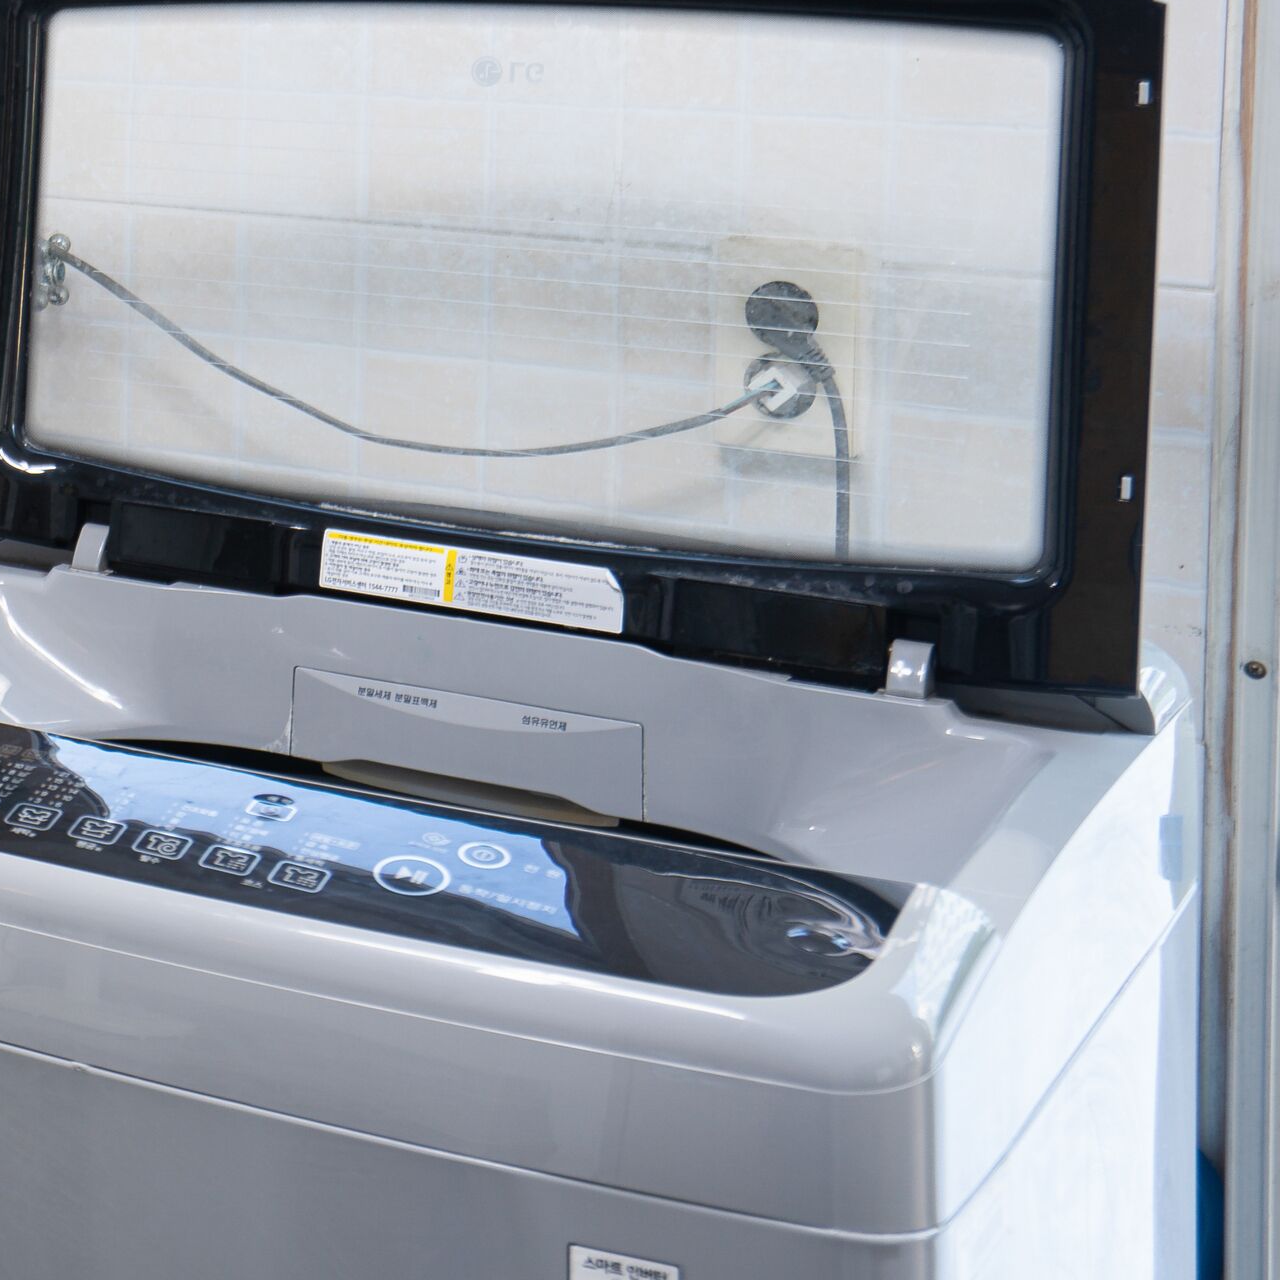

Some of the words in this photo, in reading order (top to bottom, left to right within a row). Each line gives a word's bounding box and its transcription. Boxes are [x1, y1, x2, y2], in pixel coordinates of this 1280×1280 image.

[369, 582, 399, 594] 1544-7777
[357, 685, 392, 701] 분말세제
[395, 692, 439, 710] 분말표백제
[521, 714, 567, 732] 섬유유연제
[581, 1256, 625, 1276] 스마트
